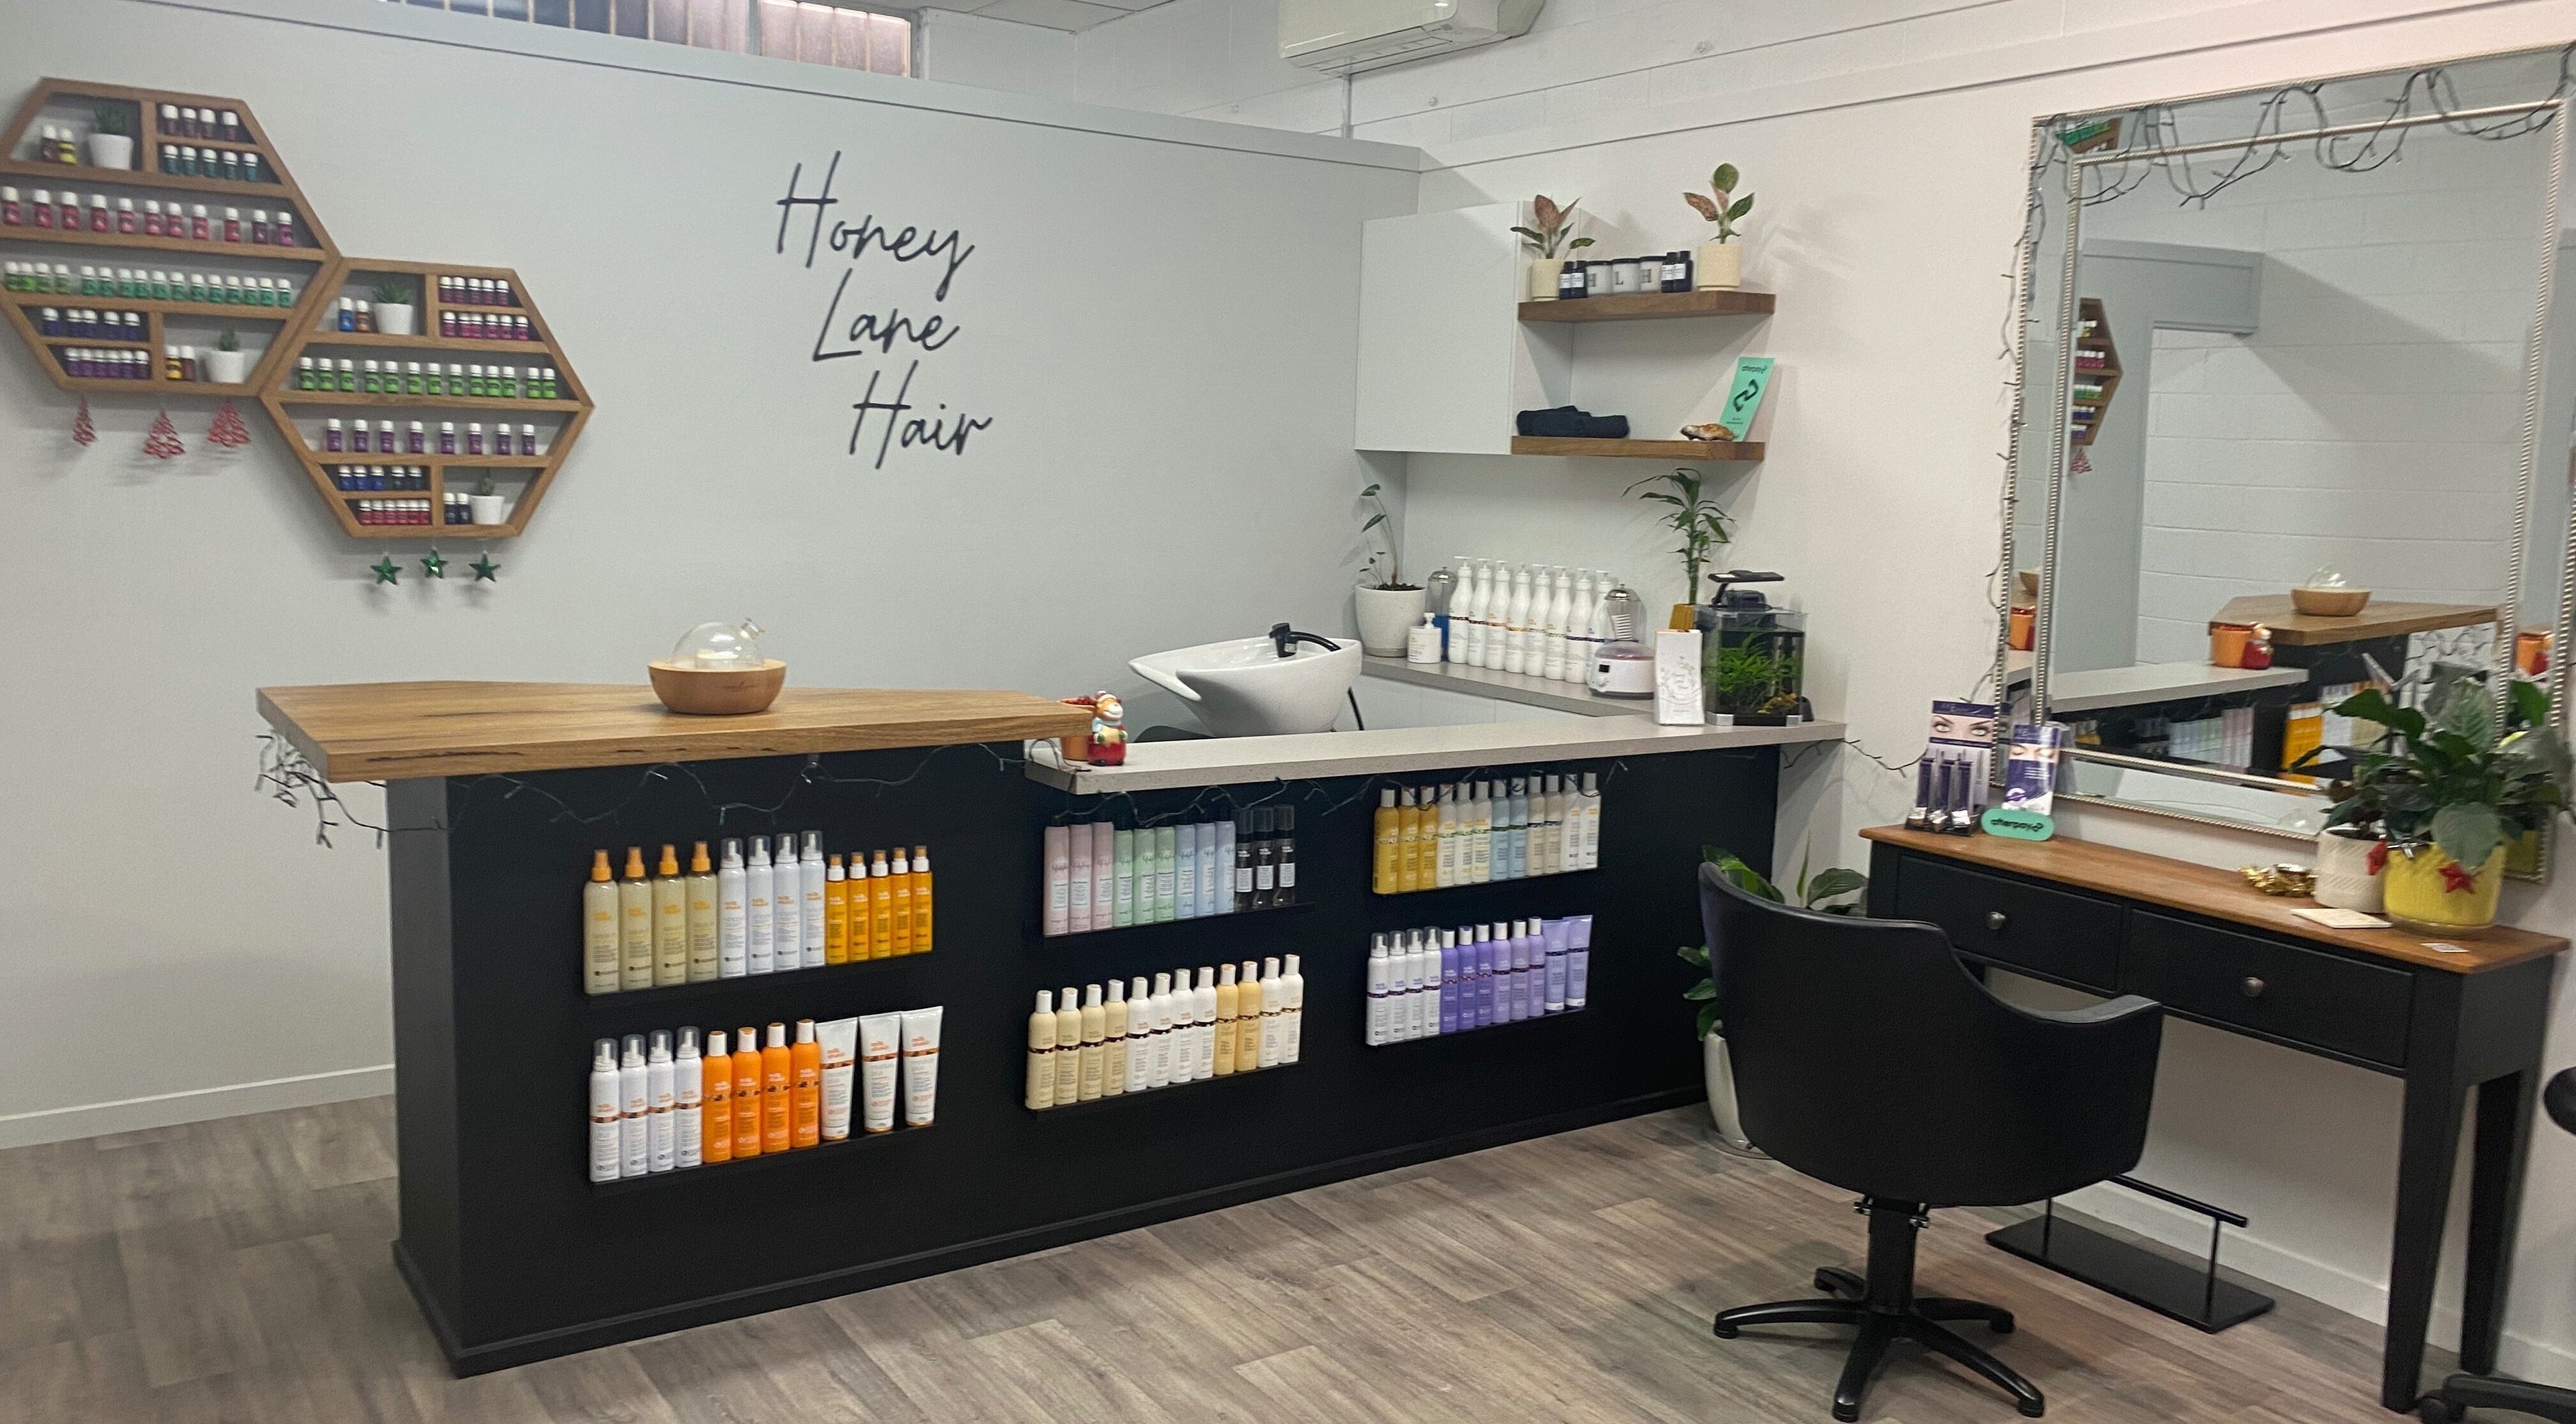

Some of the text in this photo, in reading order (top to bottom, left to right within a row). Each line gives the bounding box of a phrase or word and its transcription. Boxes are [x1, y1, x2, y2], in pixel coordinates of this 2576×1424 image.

[776, 150, 975, 303] Honey
[811, 268, 961, 362] Lane
[1615, 271, 1624, 285] L
[849, 359, 994, 470] Hair
